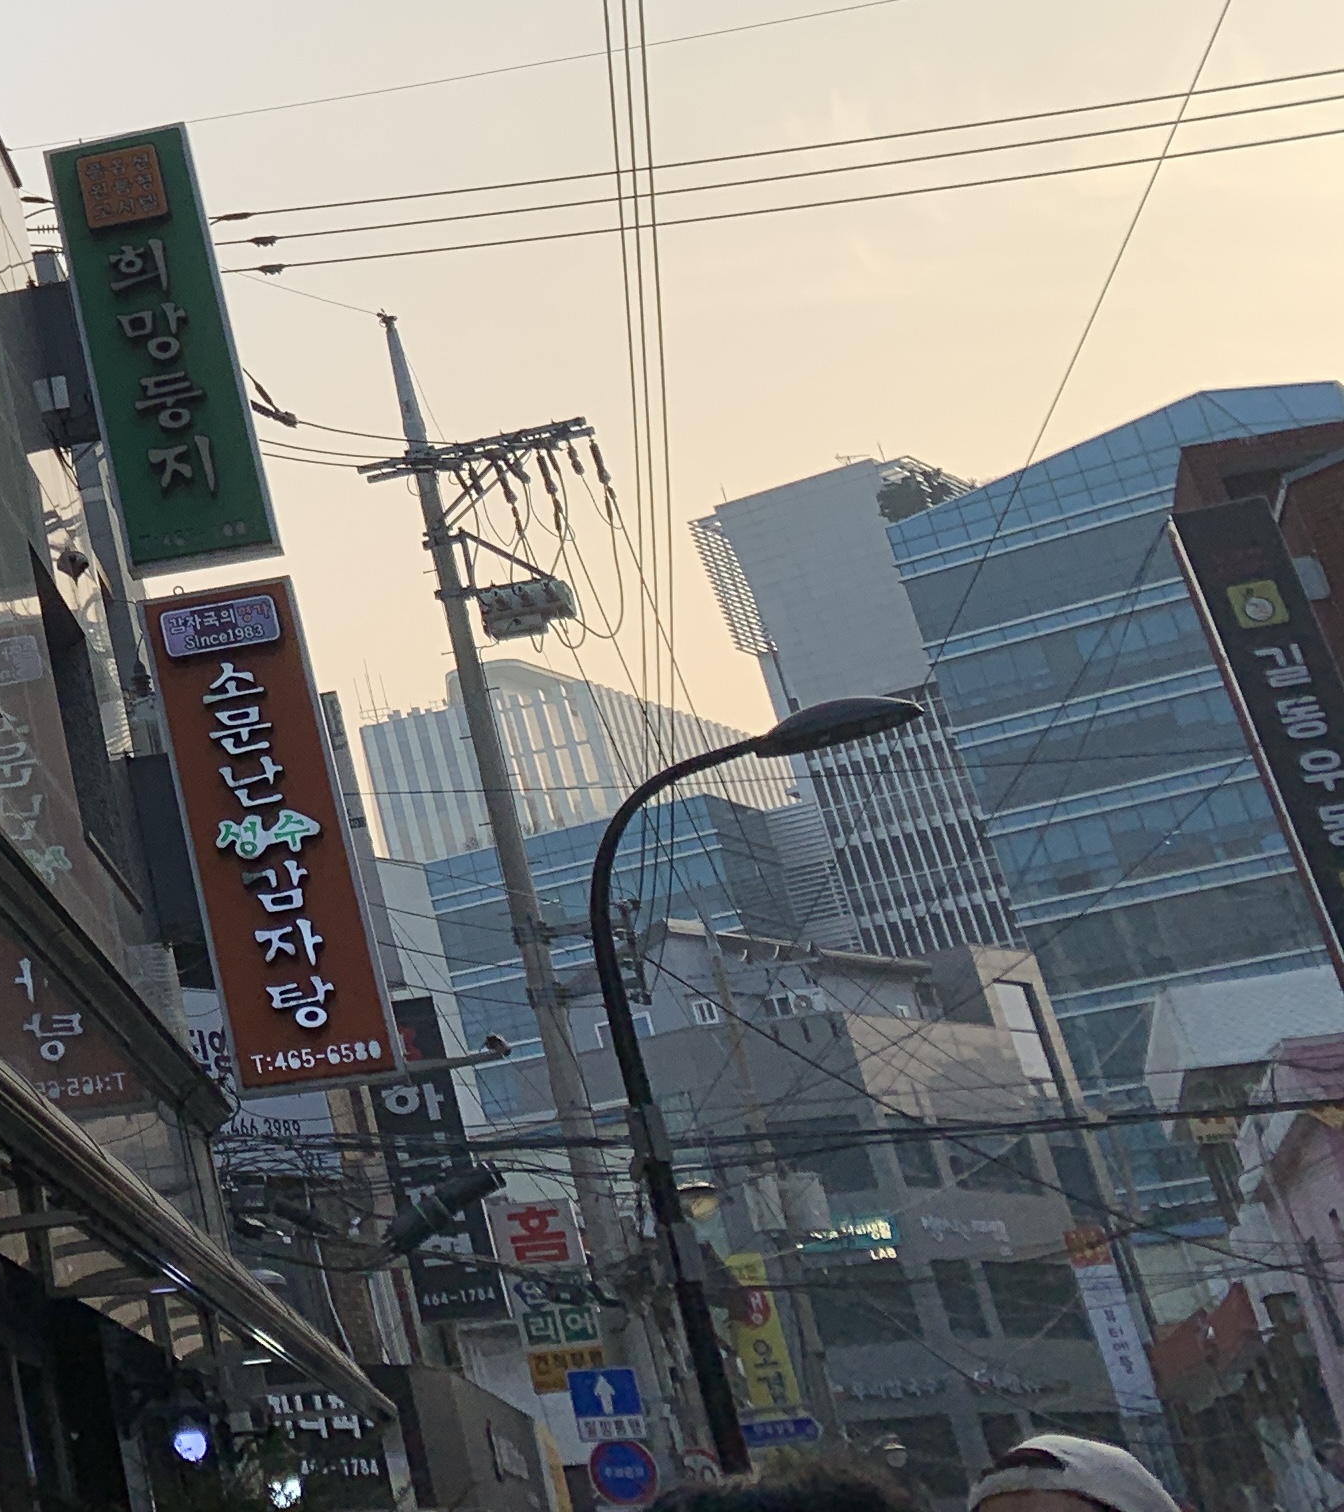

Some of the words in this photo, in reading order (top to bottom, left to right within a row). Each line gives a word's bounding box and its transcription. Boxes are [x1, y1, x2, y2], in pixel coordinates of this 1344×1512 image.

[108, 238, 220, 499] 희망둥지
[168, 607, 236, 635] 감자국의
[236, 600, 271, 624] 명가
[184, 623, 265, 650] Since1983
[202, 661, 286, 809] 소문난
[219, 812, 320, 859] 성수
[250, 859, 336, 1030] 감자탕
[250, 1039, 383, 1076] T:465-6580
[506, 1206, 570, 1265] 홈
